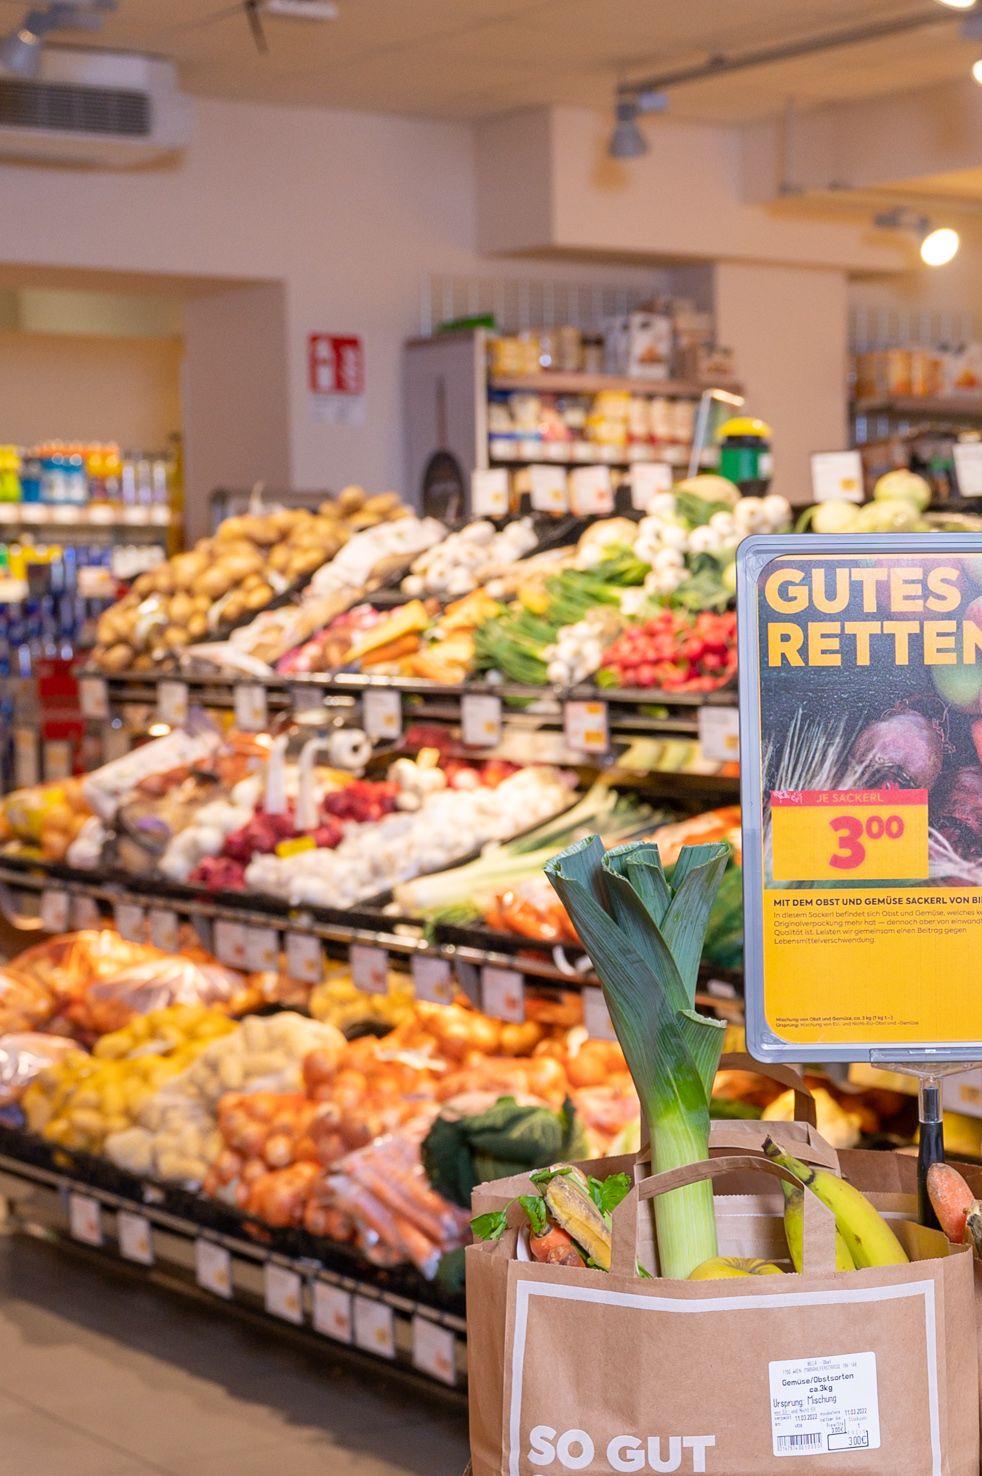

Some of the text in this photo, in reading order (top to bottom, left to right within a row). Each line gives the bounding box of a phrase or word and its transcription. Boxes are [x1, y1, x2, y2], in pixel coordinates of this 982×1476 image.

[765, 566, 962, 614] GUTES
[816, 793, 884, 803] JE SACKERL
[773, 899, 790, 907] MIT
[792, 899, 813, 907] DEM
[815, 898, 840, 906] OBST
[842, 898, 862, 906] UND
[864, 896, 903, 906] GEMÜSE
[905, 897, 947, 905] SACKERL
[773, 920, 843, 928] Originalverpackung
[854, 928, 895, 936] gemeinsam
[917, 927, 943, 935] Beitrag
[943, 927, 967, 935] gegen
[807, 1394, 837, 1405] Mischung
[526, 1424, 716, 1475] SO GUT
